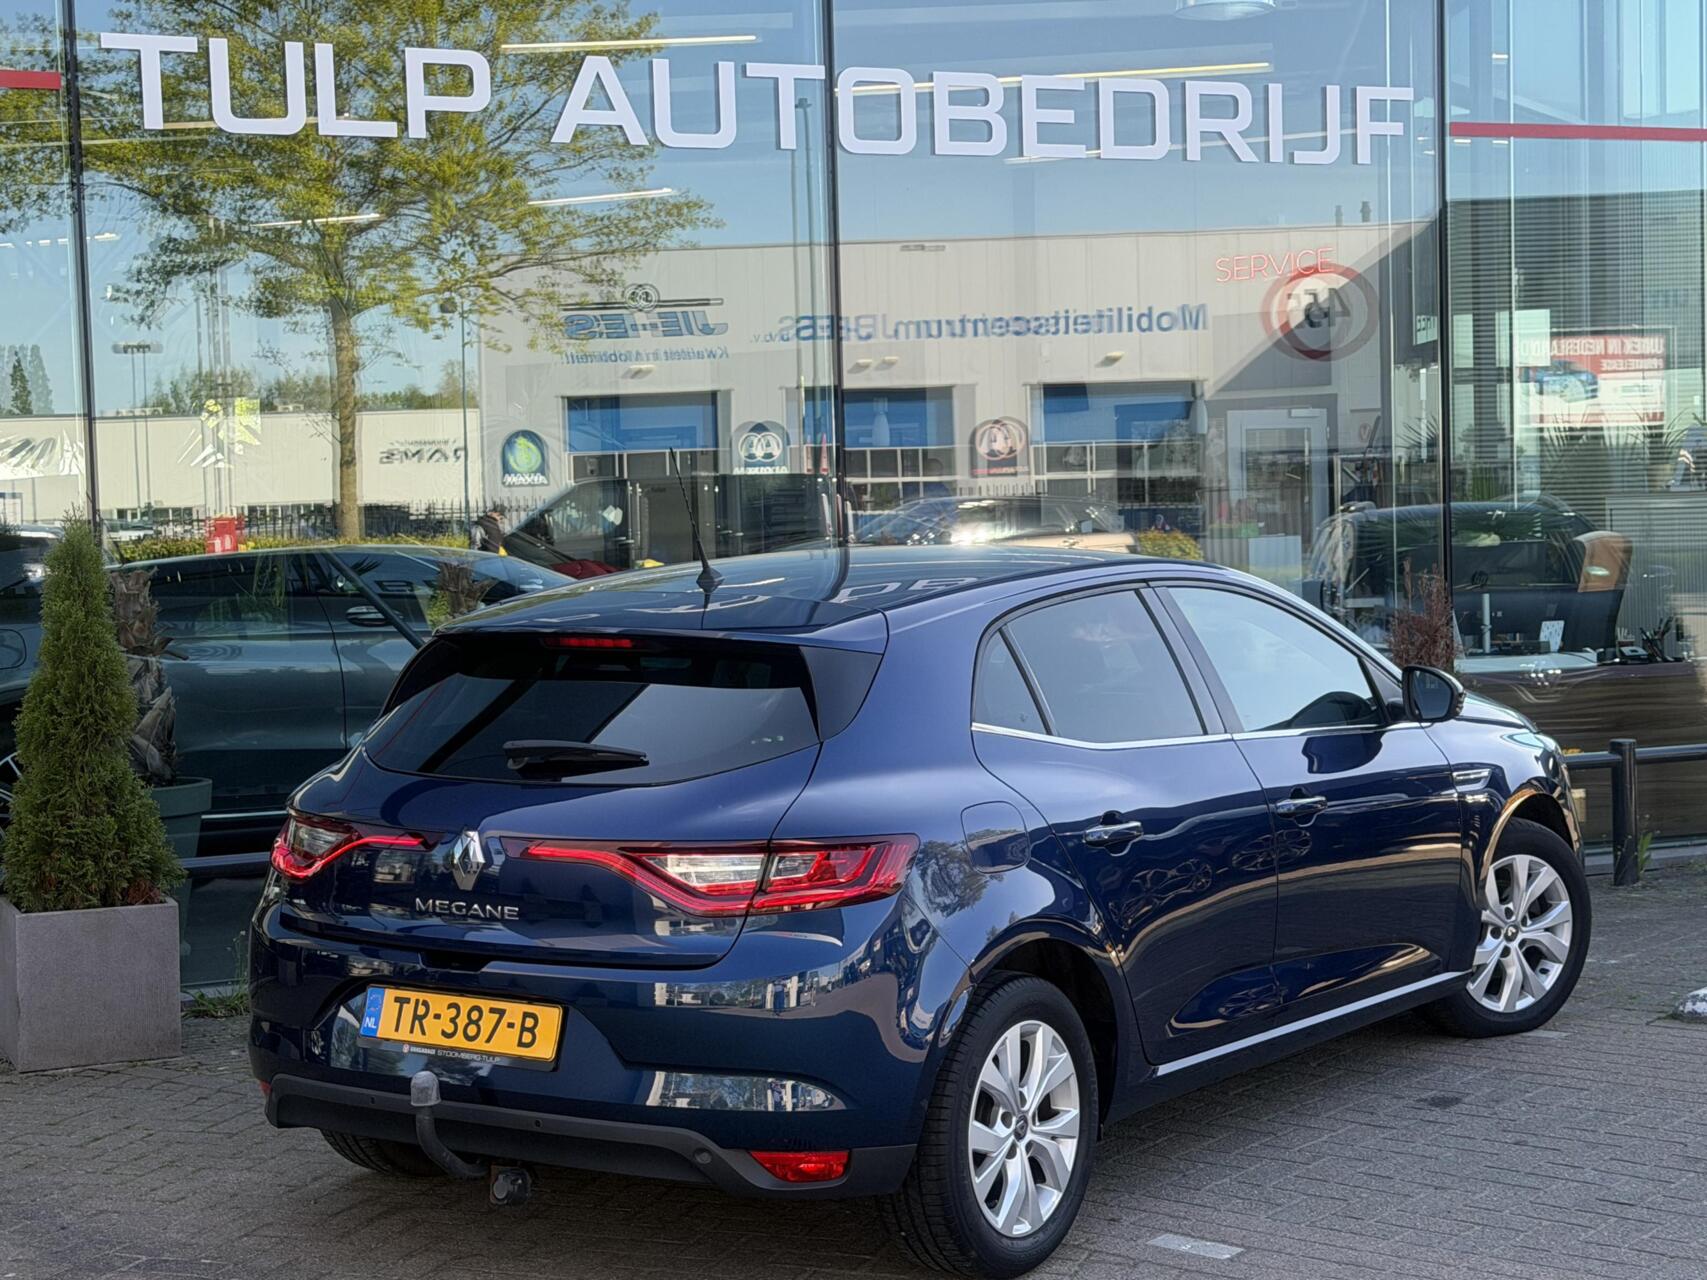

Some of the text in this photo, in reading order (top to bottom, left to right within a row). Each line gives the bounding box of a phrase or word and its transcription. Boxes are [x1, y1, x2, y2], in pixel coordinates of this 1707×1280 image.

[100, 32, 1414, 165] TULP AUTOBEDRIJF
[1215, 246, 1334, 283] SERVICE
[415, 897, 520, 920] MEGANE
[364, 1016, 377, 1029] NL
[393, 995, 540, 1049] TR-387-B
